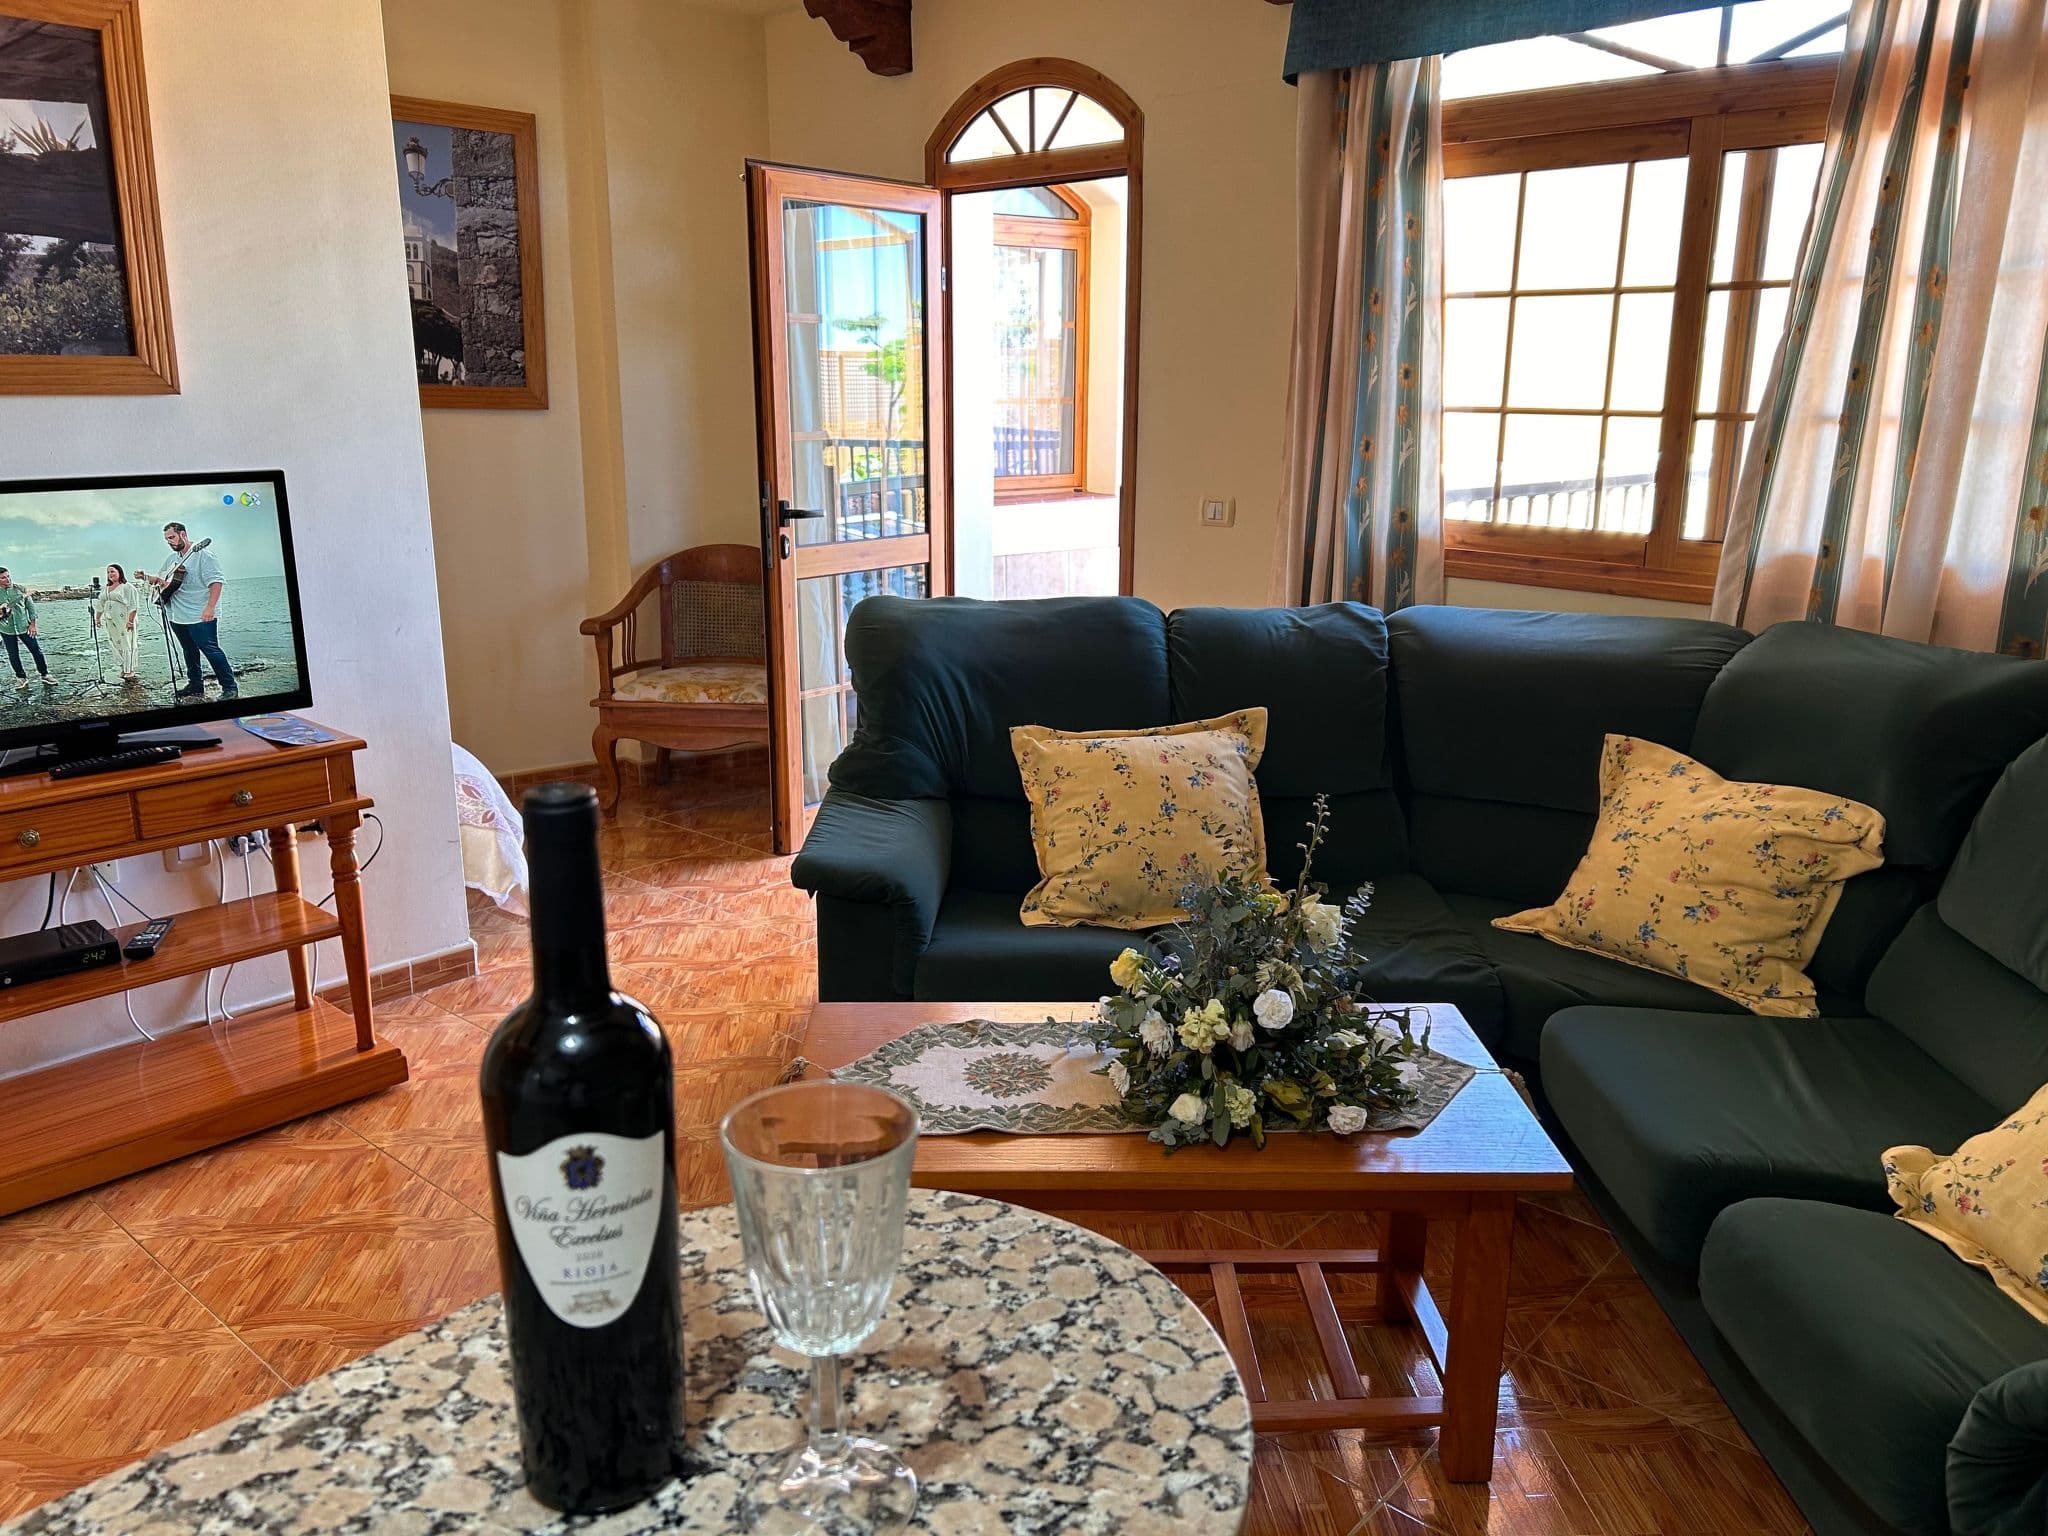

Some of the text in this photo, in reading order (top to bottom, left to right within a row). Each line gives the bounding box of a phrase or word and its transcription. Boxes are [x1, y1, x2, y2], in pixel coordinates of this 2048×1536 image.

[82, 949, 106, 963] 242
[515, 1189, 653, 1222] Viña Herminia
[563, 1262, 618, 1279] RIOJA
